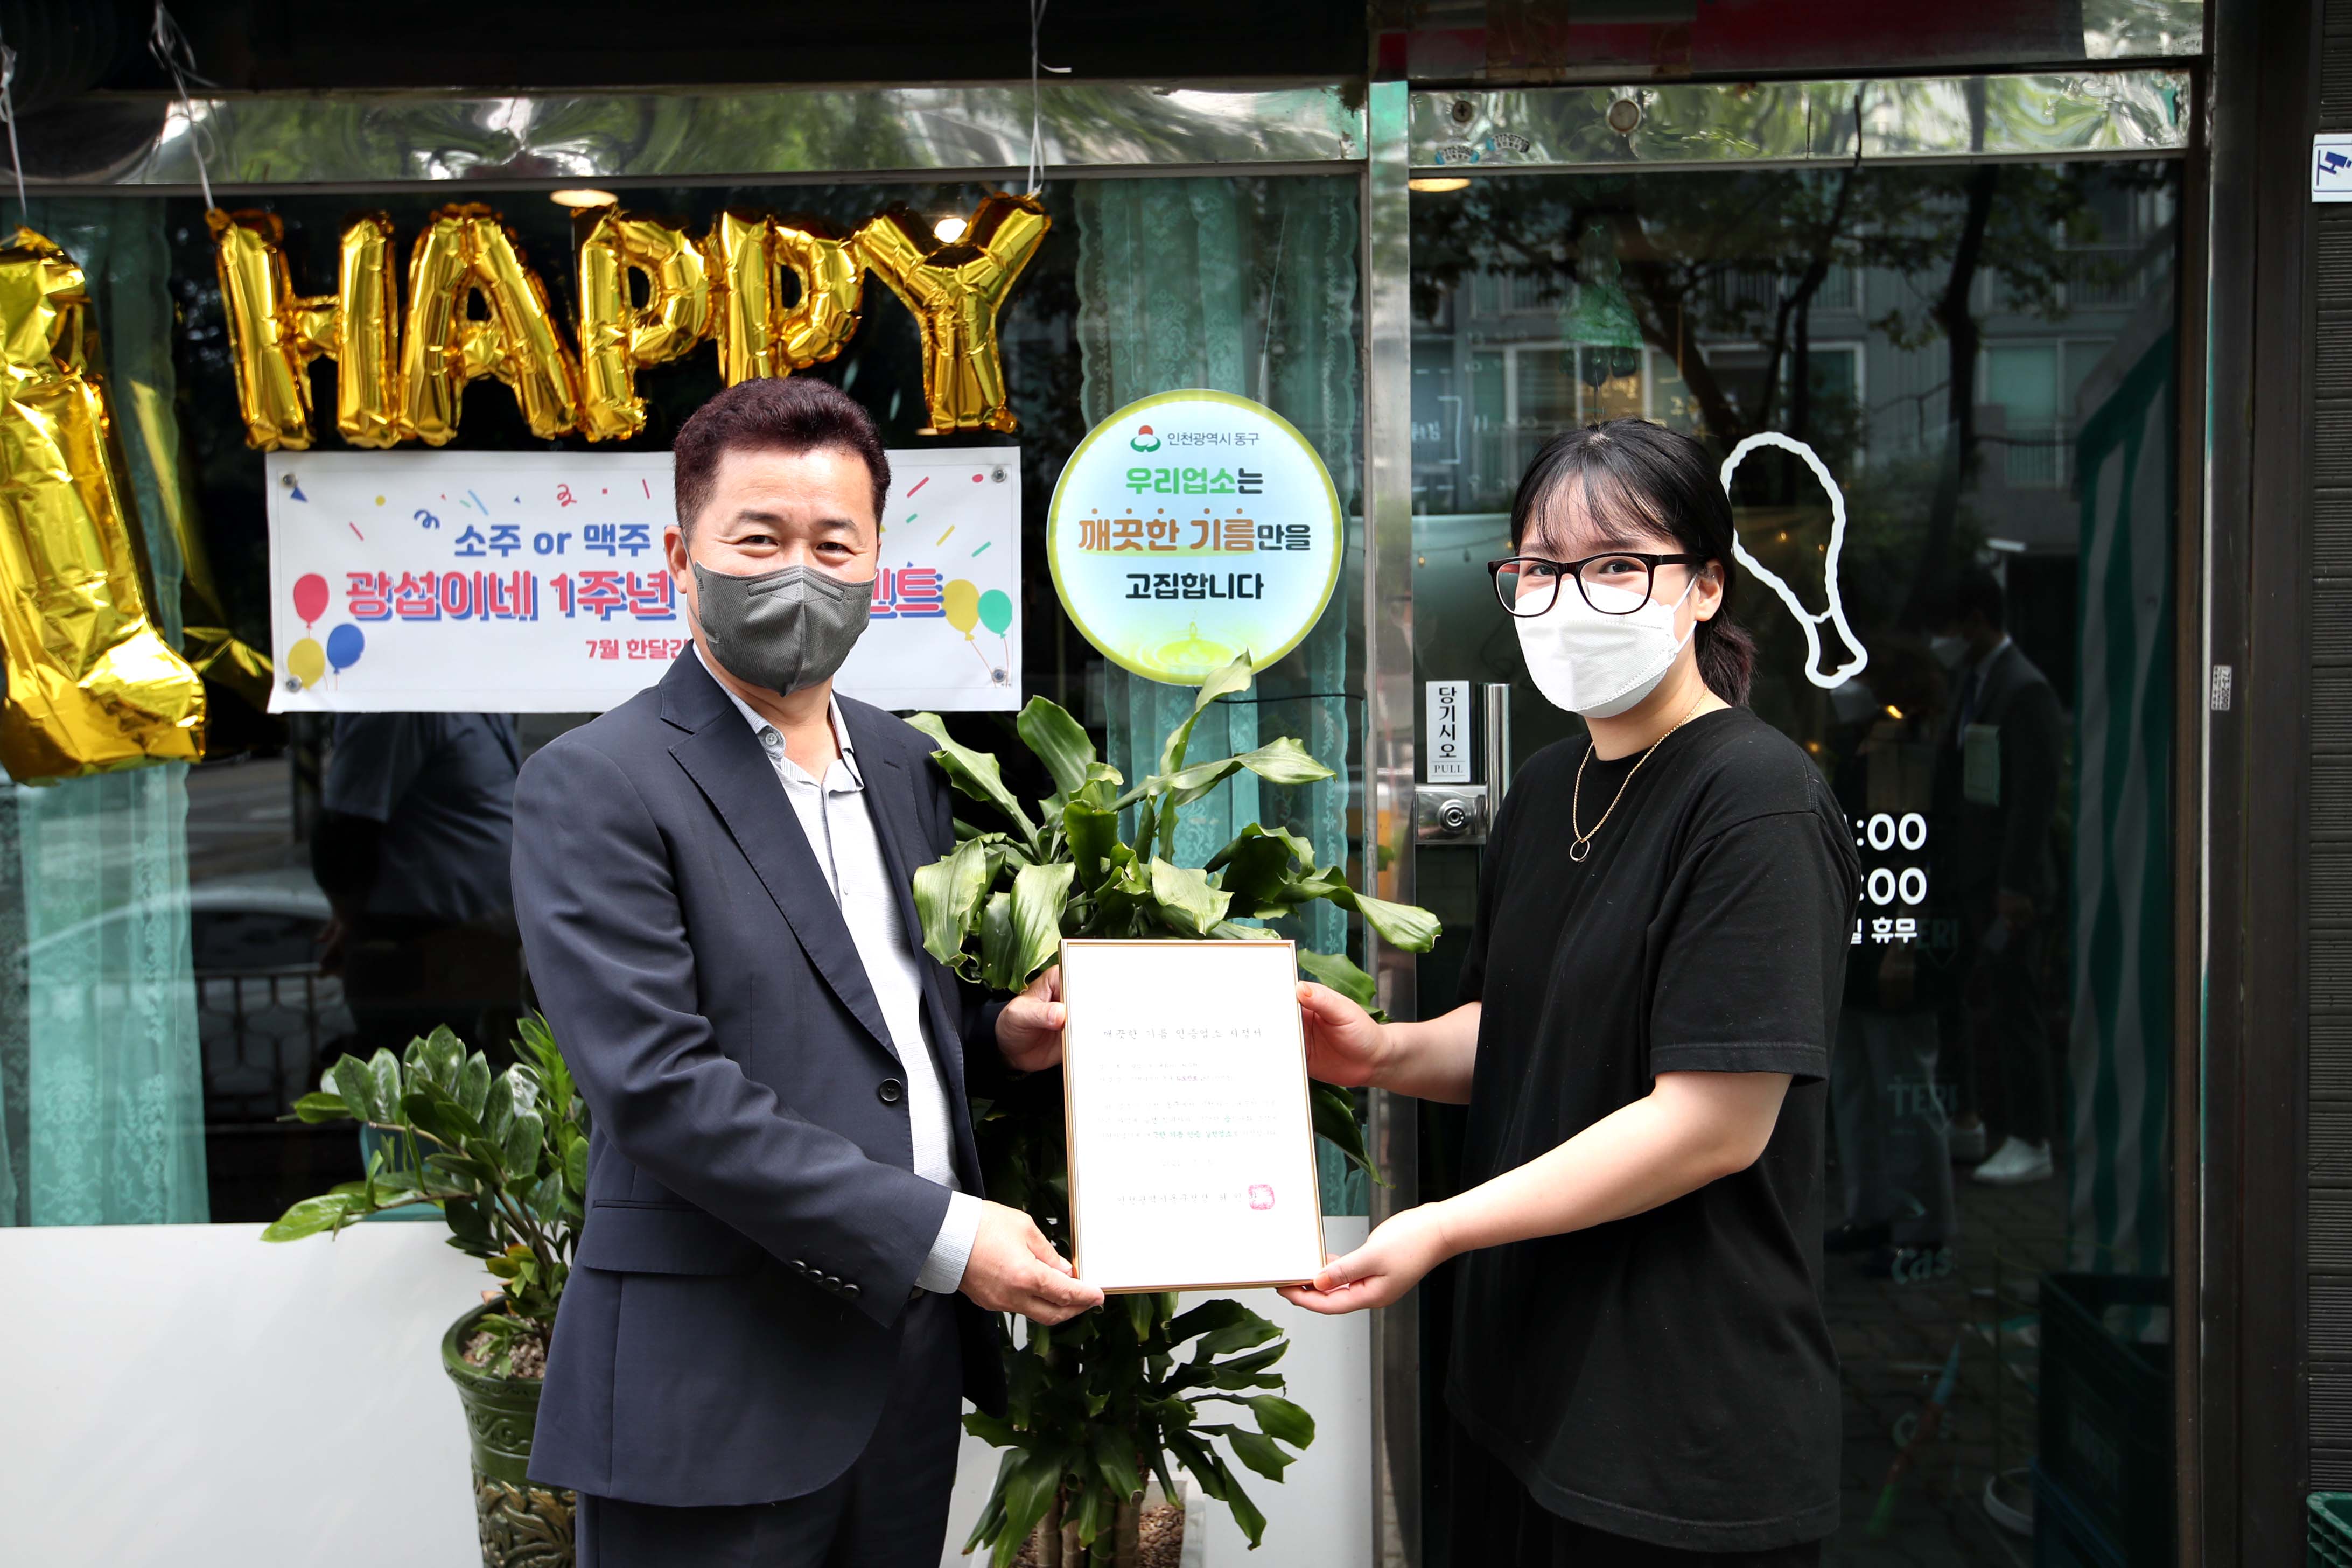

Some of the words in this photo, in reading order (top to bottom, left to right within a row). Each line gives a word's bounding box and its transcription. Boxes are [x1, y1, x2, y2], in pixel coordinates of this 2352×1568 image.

[206, 193, 1052, 449] HAPPY
[1167, 432, 1231, 446] 인천광역시
[1234, 432, 1260, 446] 동구
[1125, 467, 1264, 494] 우리업소는
[454, 524, 521, 557] 소주
[533, 530, 572, 555] or
[584, 523, 651, 557] 맥주
[1078, 518, 1180, 551] 깨끗한
[1189, 518, 1311, 551] 기름만을
[346, 570, 539, 621] 광섭이네
[550, 569, 677, 621] 1주년
[1125, 572, 1265, 600] 고집합니다
[585, 638, 619, 660] 7월
[1438, 686, 1458, 759] 당기시오
[1434, 764, 1464, 774] PULL
[1843, 812, 1927, 851] :00
[1871, 916, 1918, 944] 휴무
